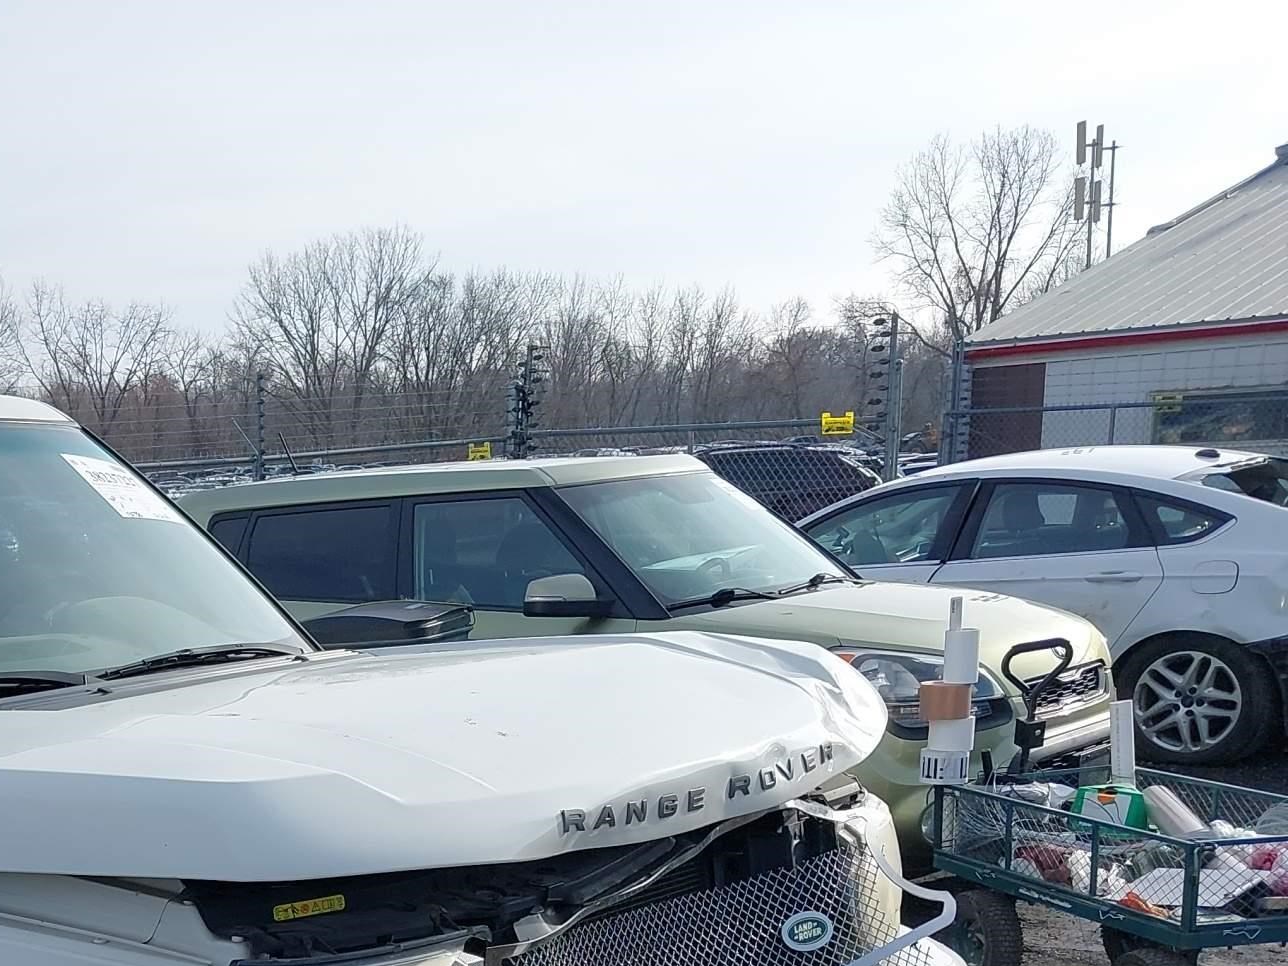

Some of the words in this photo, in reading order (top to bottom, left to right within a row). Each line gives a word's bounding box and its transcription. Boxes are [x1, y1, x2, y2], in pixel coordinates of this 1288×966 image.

[560, 787, 706, 834] RANGE
[727, 742, 833, 800] ROVER
[793, 921, 814, 934] LAND
[798, 927, 822, 941] ROVER
